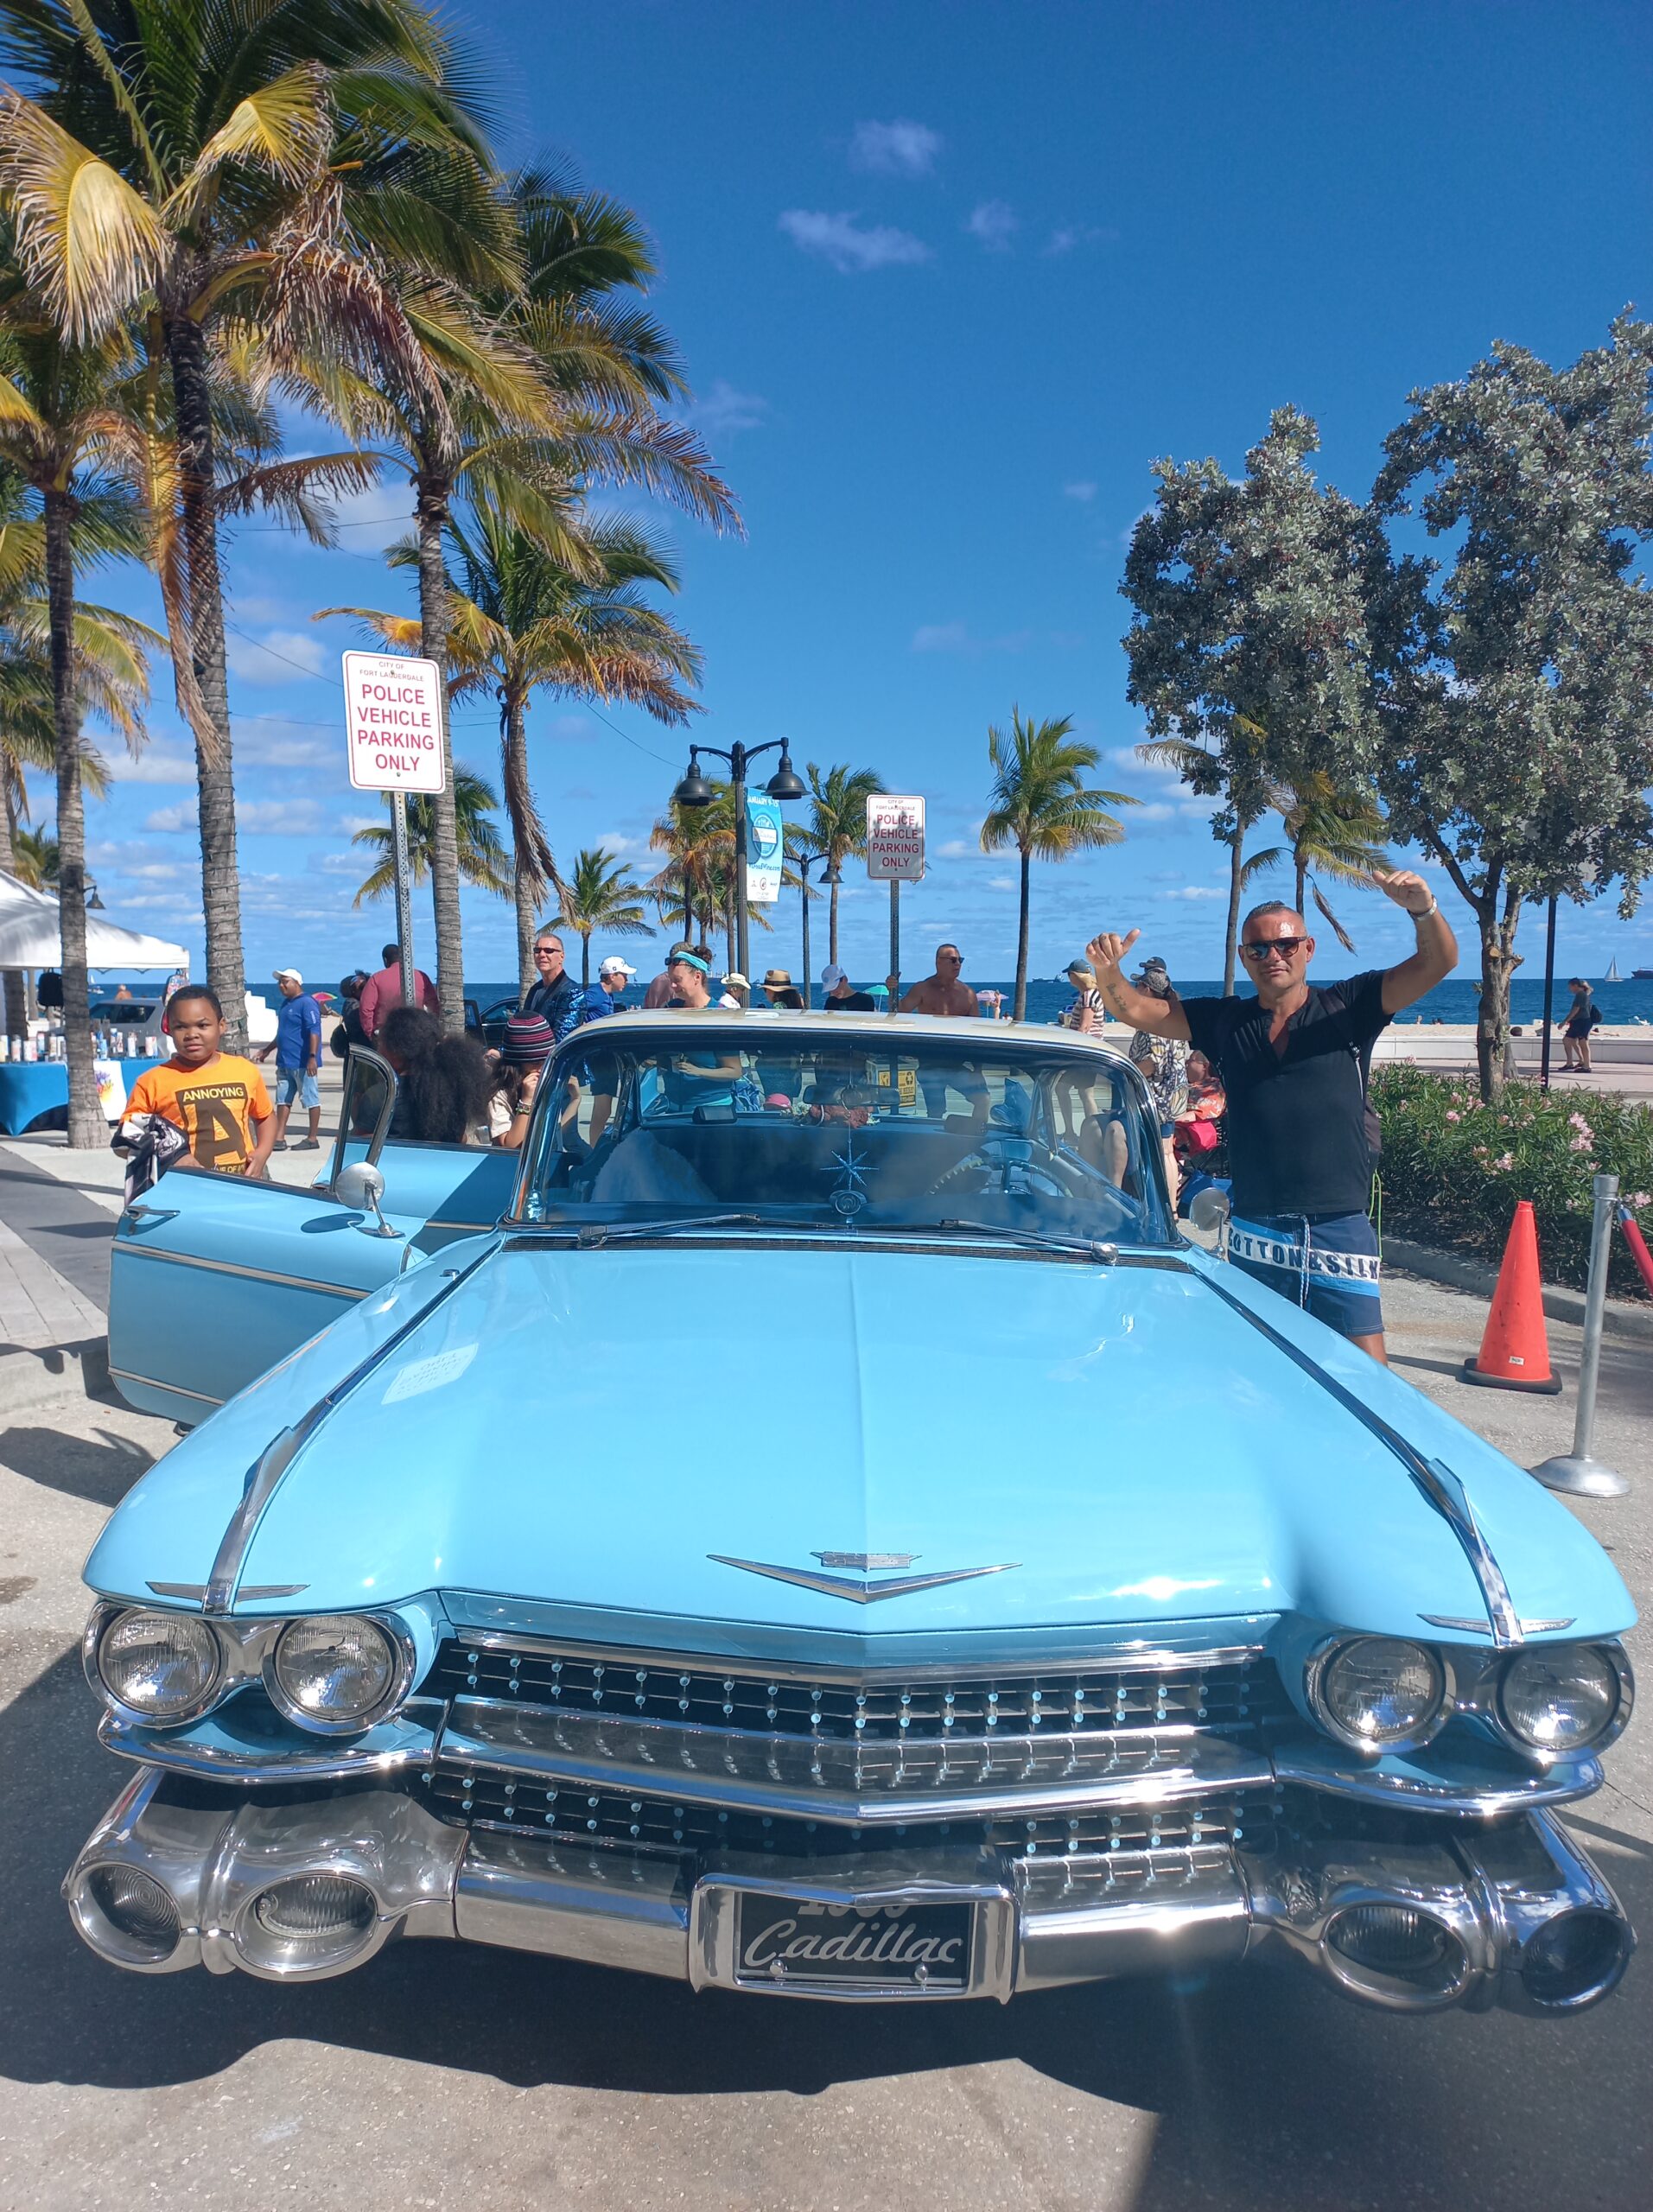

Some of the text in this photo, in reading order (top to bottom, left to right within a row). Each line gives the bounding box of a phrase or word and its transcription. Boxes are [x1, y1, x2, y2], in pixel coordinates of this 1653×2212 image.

[379, 671, 424, 682] LAUDERDALE
[362, 683, 425, 705] POLICE
[357, 706, 432, 728] VEHICLE
[358, 729, 435, 750] PARKING
[375, 753, 420, 772] ONLY
[876, 814, 915, 825] POLICE
[873, 829, 919, 839] VEHICLE
[872, 842, 919, 854] PARKING
[881, 856, 910, 868] ONLY
[182, 1086, 244, 1102] ANNOYING
[744, 1918, 963, 1967] Cadillac
